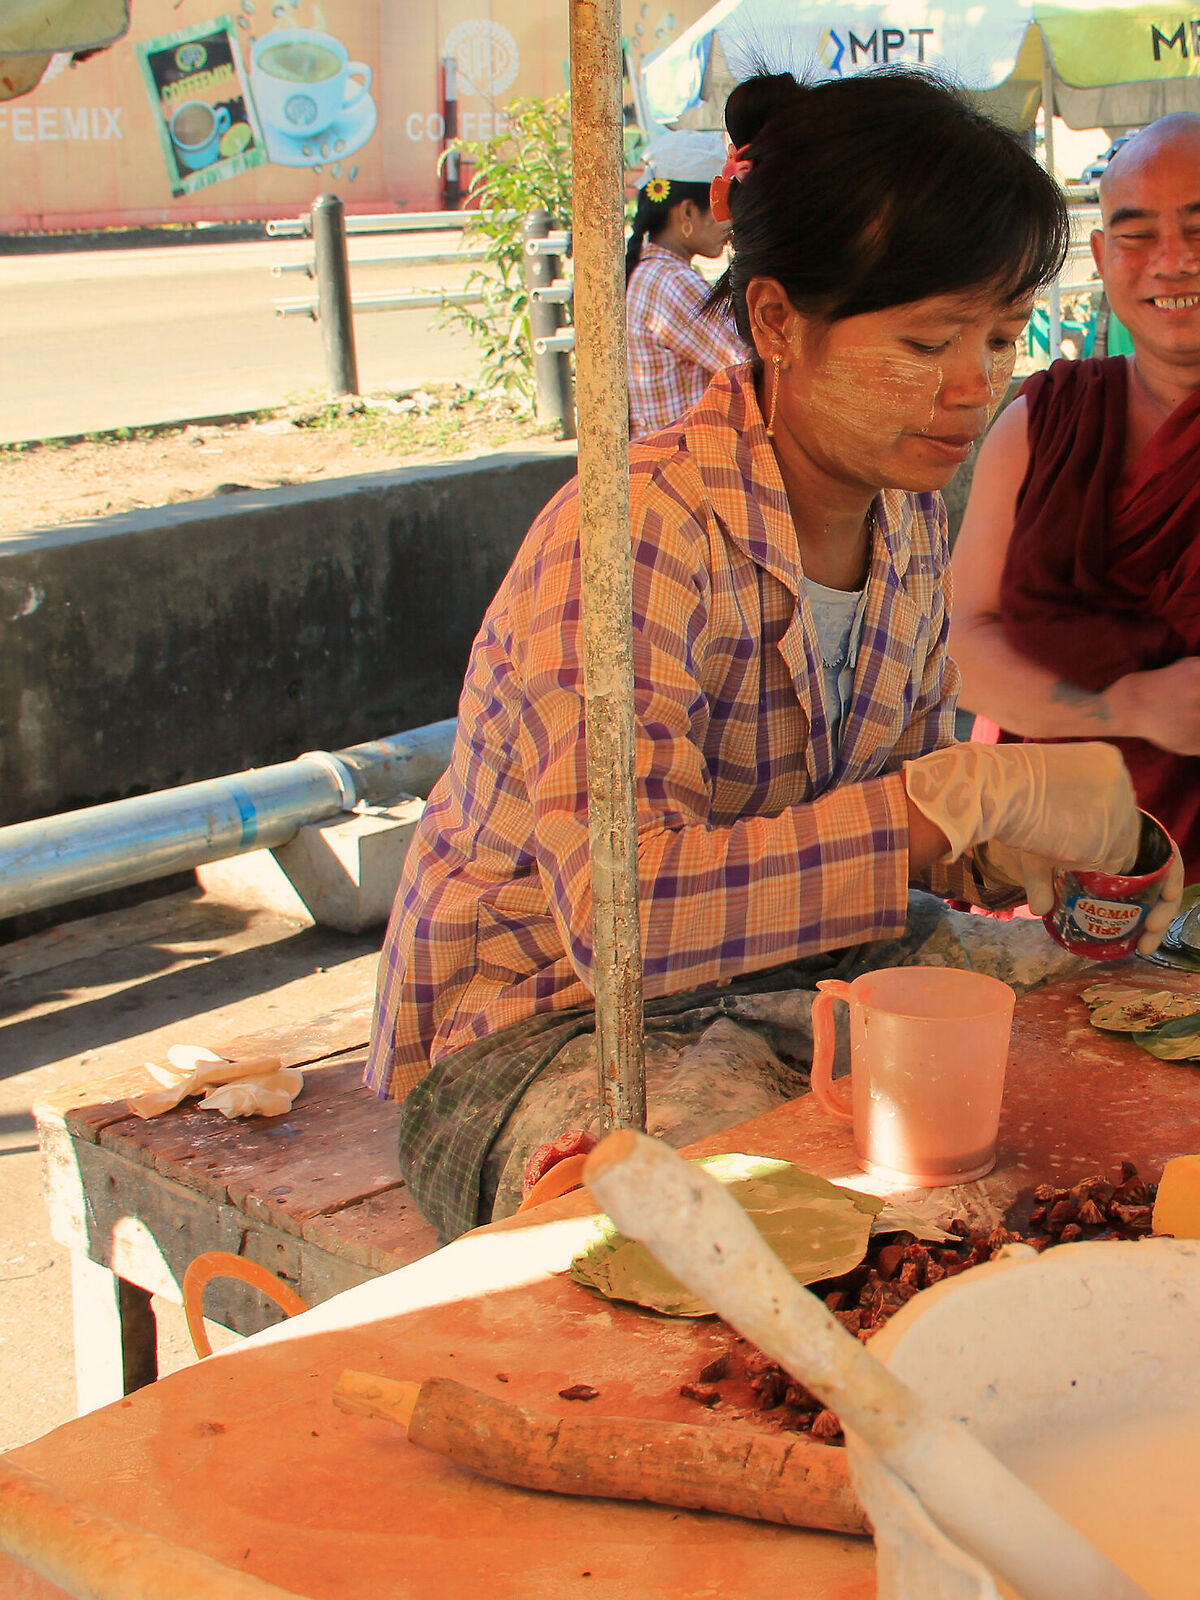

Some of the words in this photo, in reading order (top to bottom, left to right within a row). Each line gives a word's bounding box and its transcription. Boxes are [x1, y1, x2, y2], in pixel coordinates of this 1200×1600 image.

[847, 29, 934, 64] MPT
[161, 61, 236, 102] COFFEEMIX
[1078, 900, 1143, 920] JAGMAG
